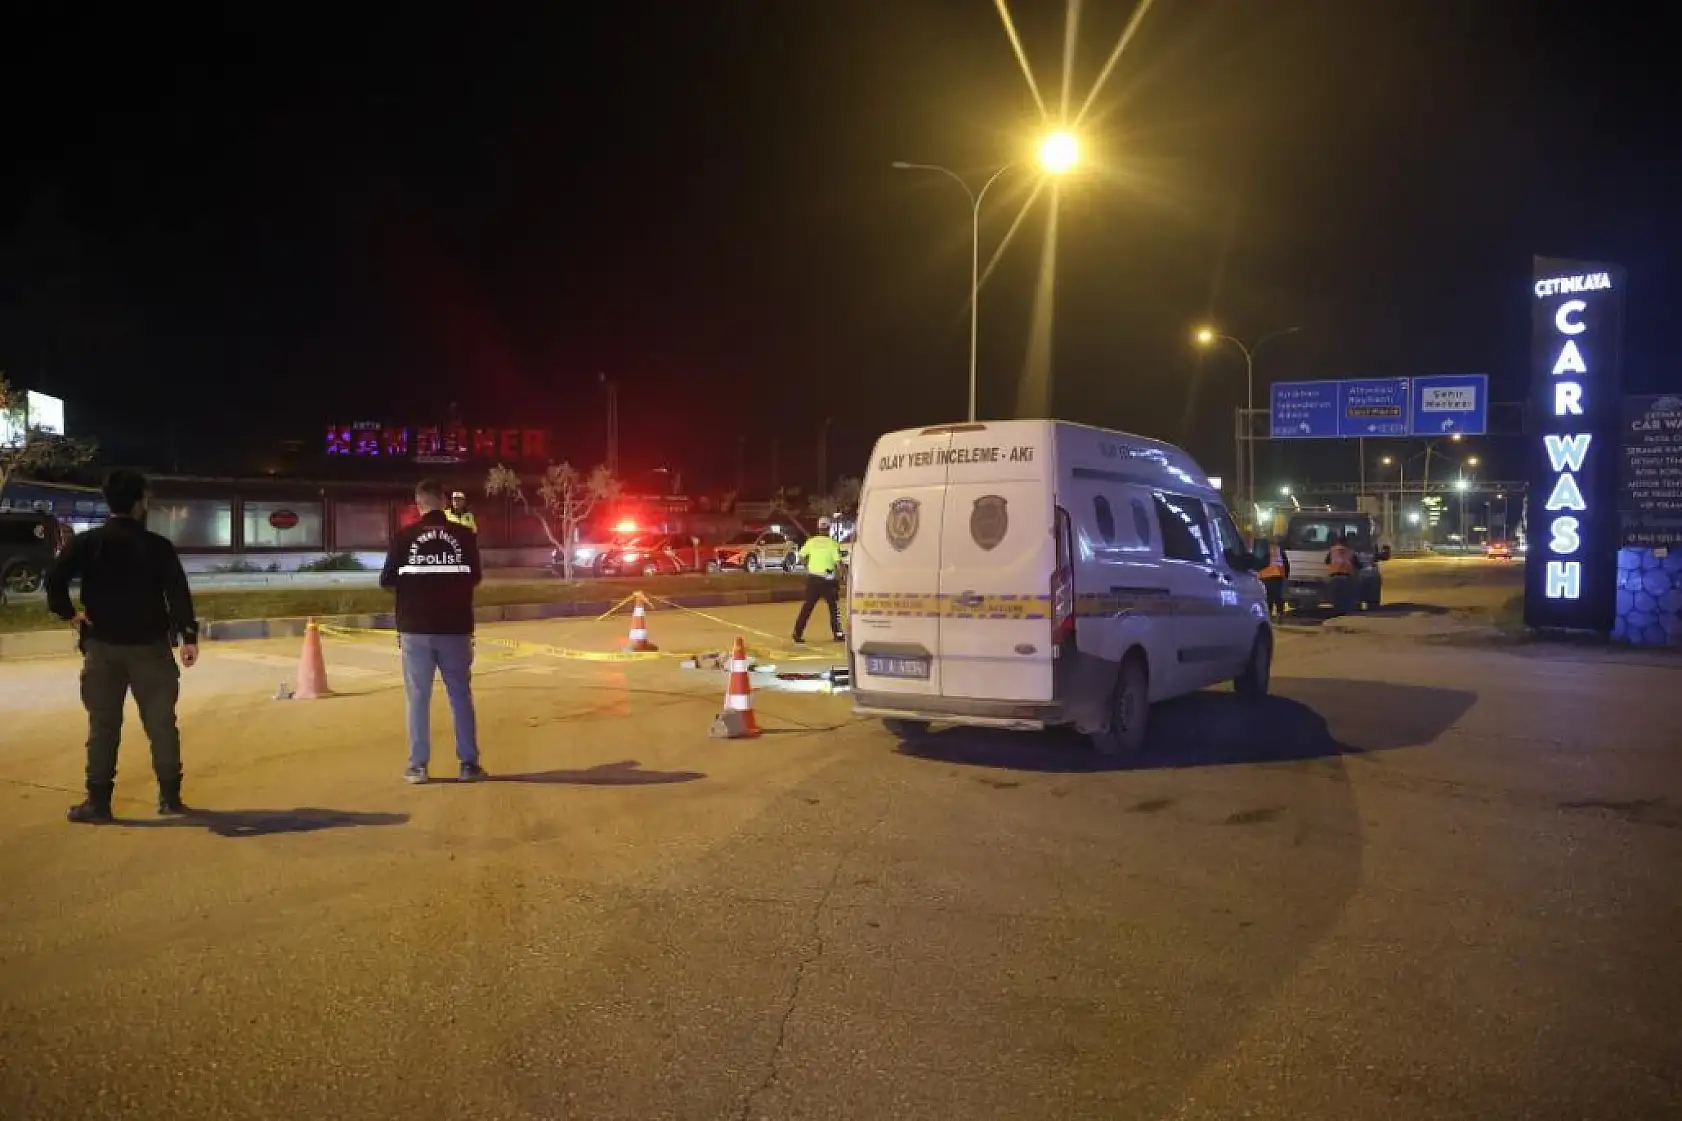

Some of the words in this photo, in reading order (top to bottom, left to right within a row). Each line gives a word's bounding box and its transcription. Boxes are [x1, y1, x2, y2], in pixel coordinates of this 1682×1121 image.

[1534, 272, 1612, 299] ÇETİNKAYA
[1552, 299, 1587, 416] CAR
[878, 453, 905, 471] OLAY
[908, 447, 933, 467] YERİ
[936, 446, 999, 465] İNCELEME
[1543, 433, 1592, 600] WASH
